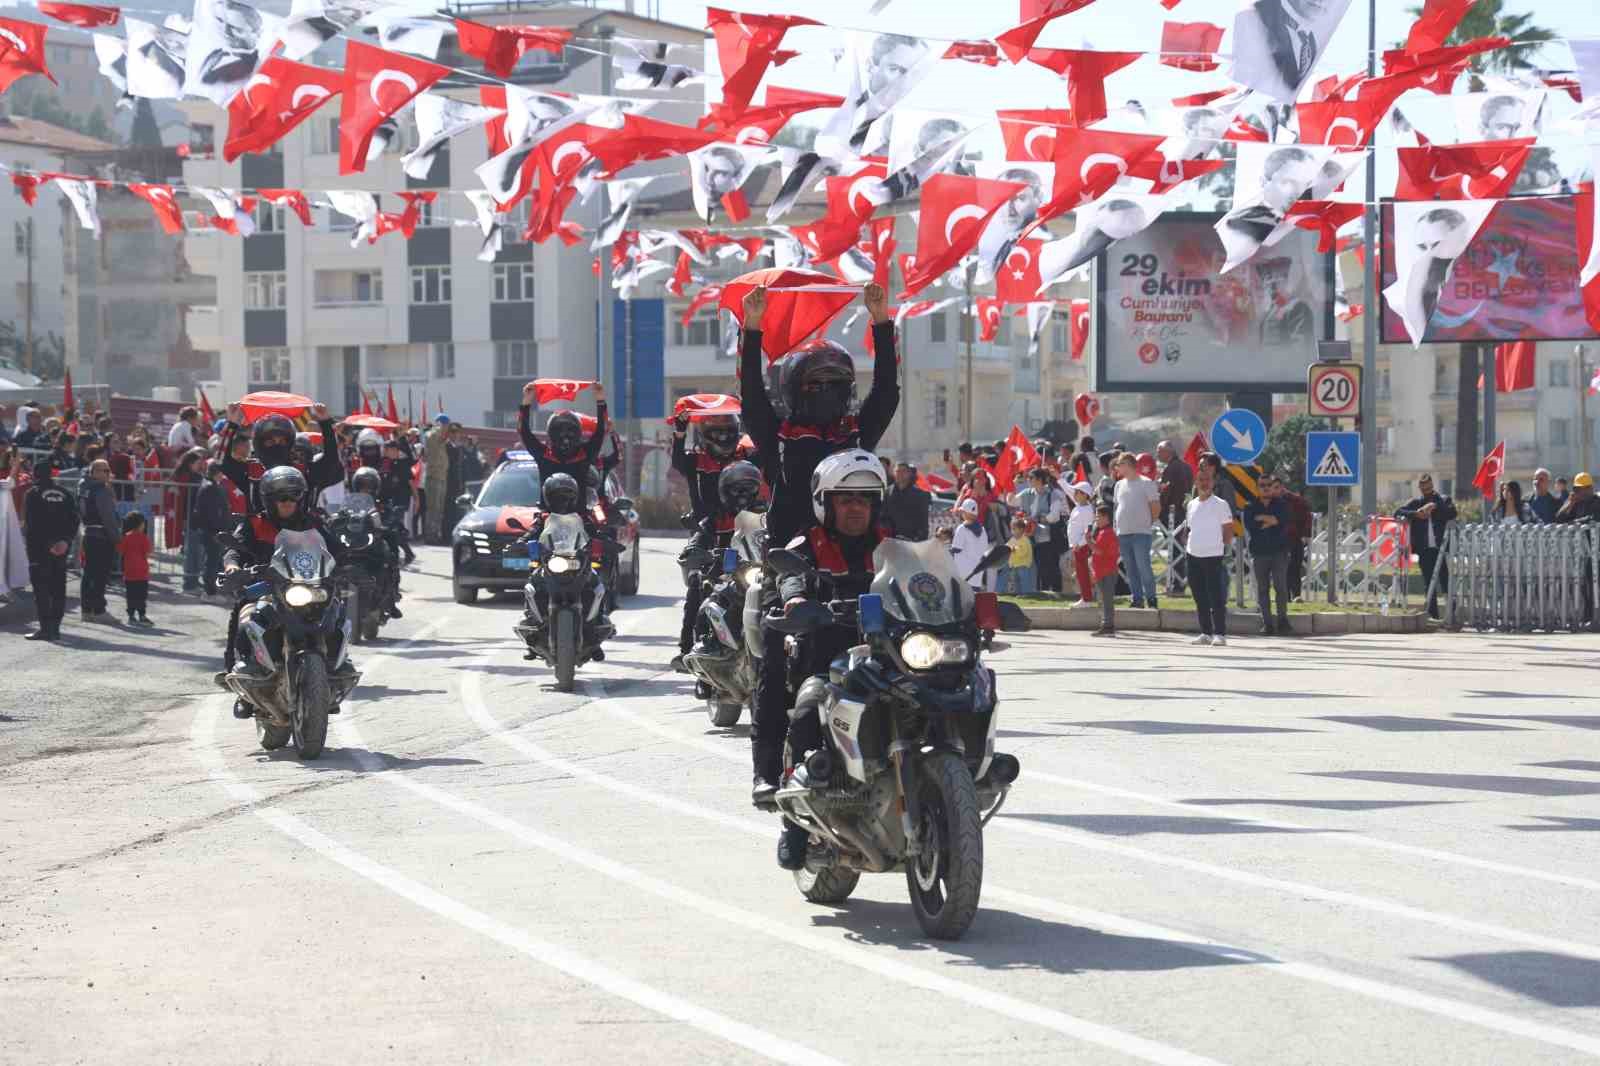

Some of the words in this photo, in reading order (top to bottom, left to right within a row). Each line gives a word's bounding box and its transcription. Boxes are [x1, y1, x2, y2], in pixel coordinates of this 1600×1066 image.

[1120, 253, 1159, 277] 29
[1141, 272, 1212, 296] ekim
[1322, 377, 1350, 402] 20
[833, 717, 850, 732] GS
